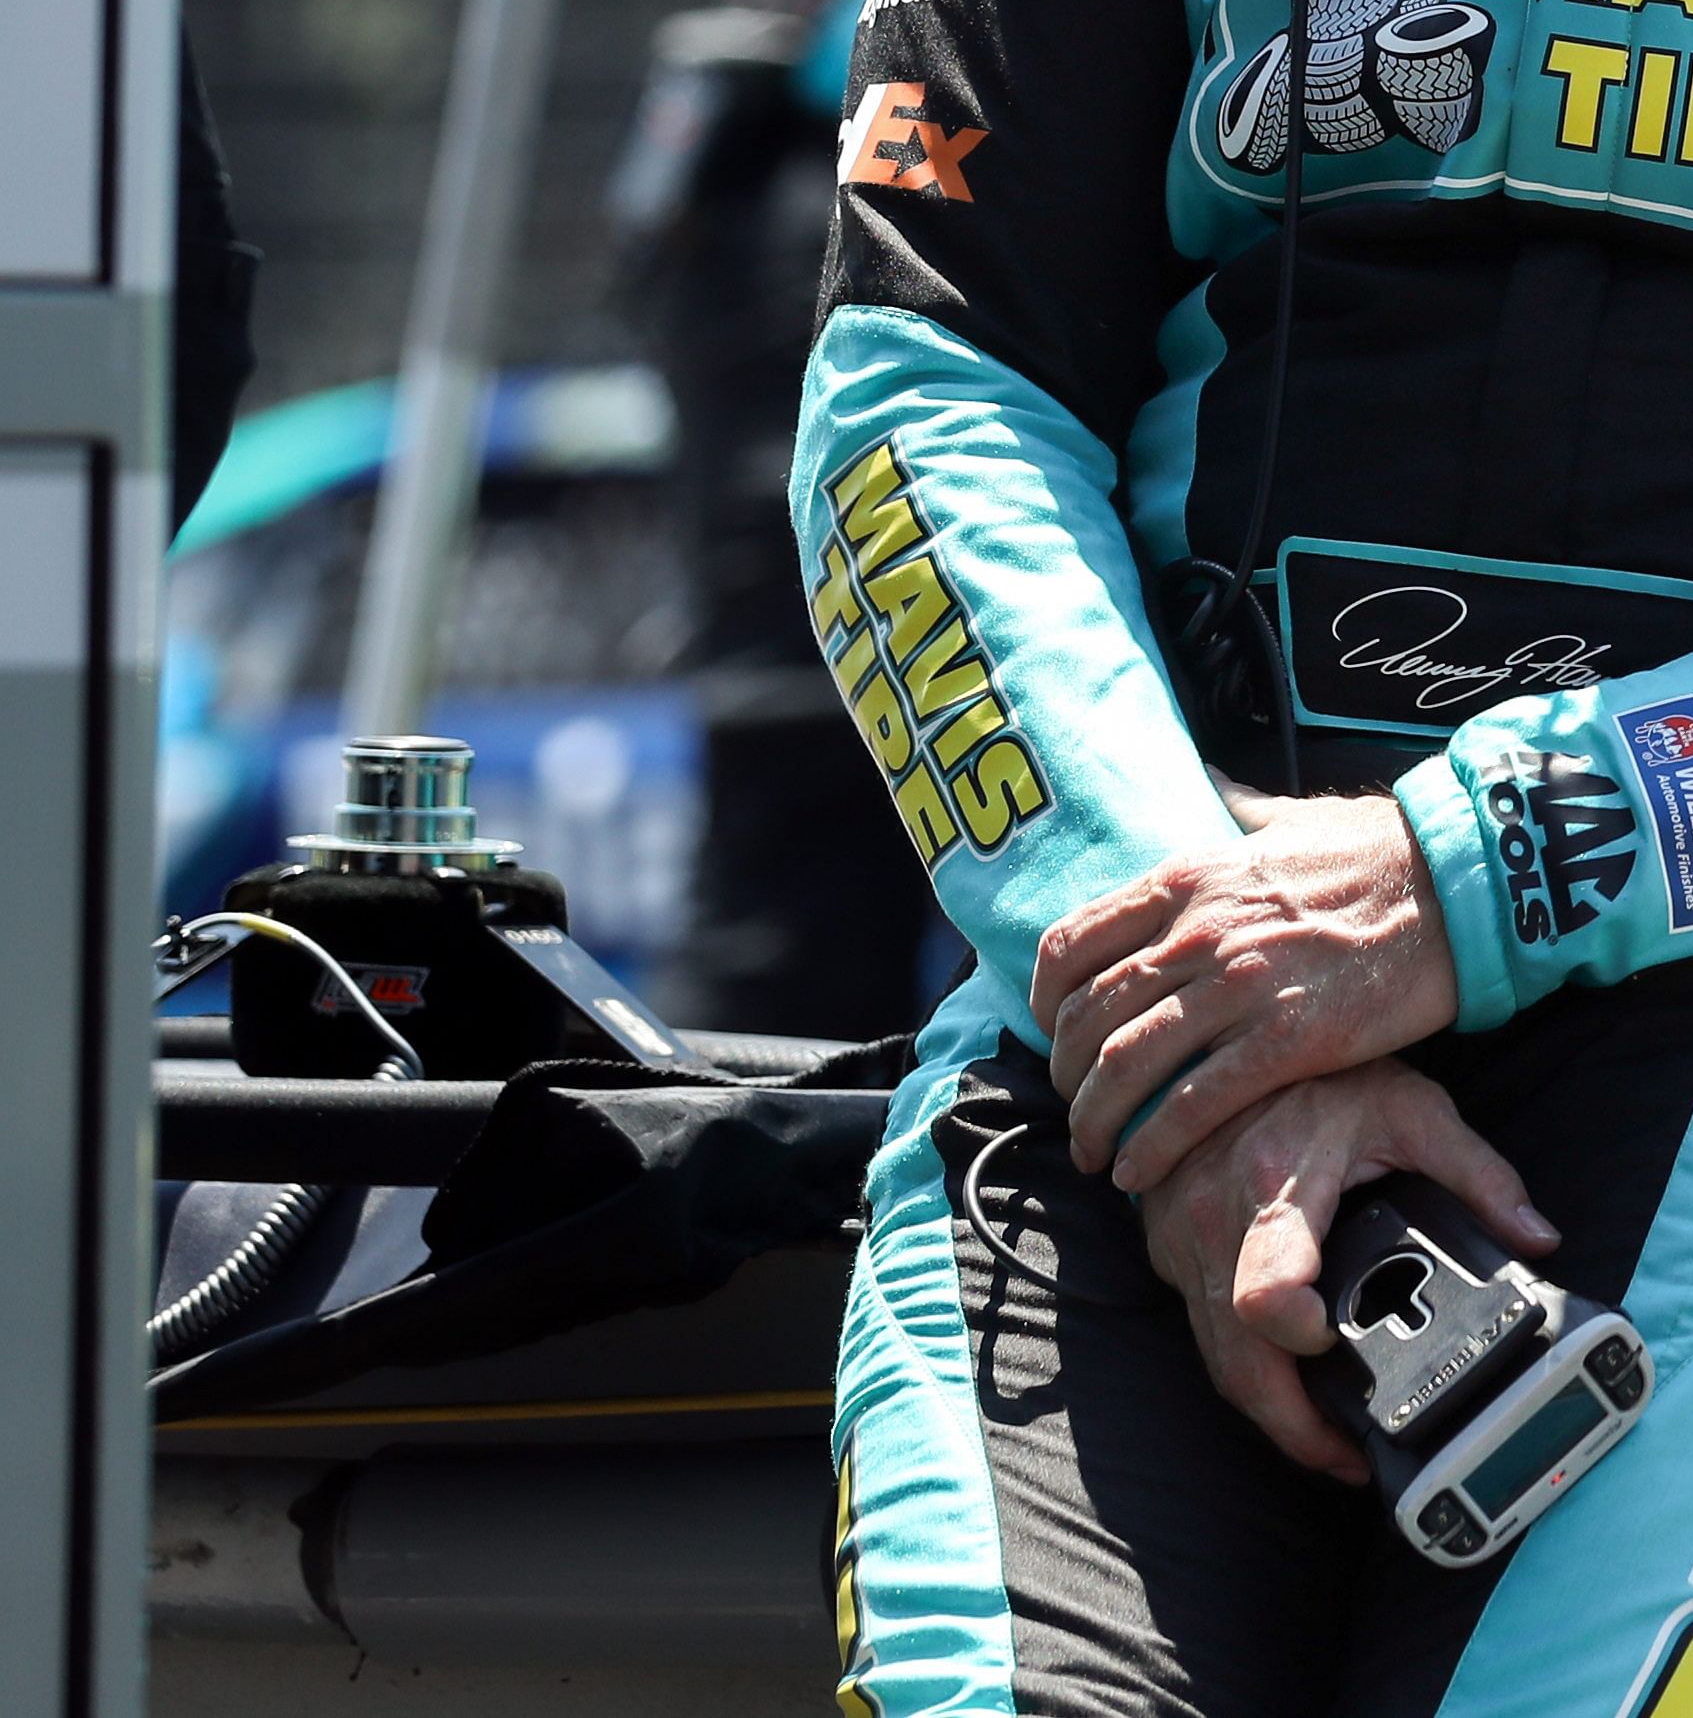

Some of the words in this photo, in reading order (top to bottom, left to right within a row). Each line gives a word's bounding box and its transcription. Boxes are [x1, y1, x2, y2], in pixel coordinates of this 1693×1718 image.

[812, 542, 965, 871] TIRE
[831, 439, 1052, 854] MAVIS
[1478, 751, 1551, 945] TOOLS
[1656, 773, 1686, 851] Automotive
